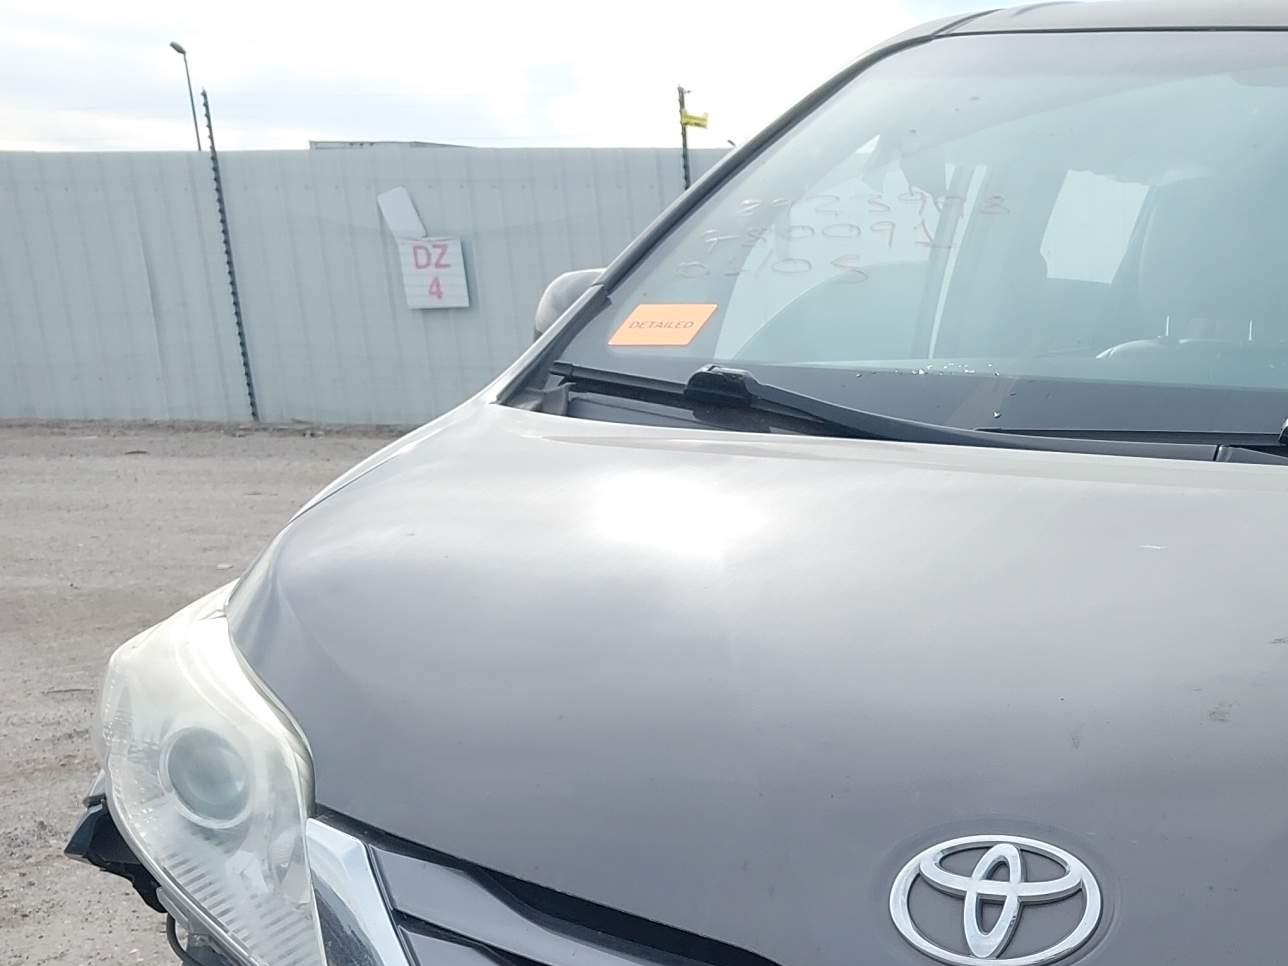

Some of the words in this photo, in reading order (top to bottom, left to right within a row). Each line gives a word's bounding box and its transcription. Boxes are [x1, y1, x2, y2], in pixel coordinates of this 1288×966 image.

[412, 244, 451, 269] DZ
[428, 276, 443, 300] 4
[629, 321, 695, 329] DETAILED
